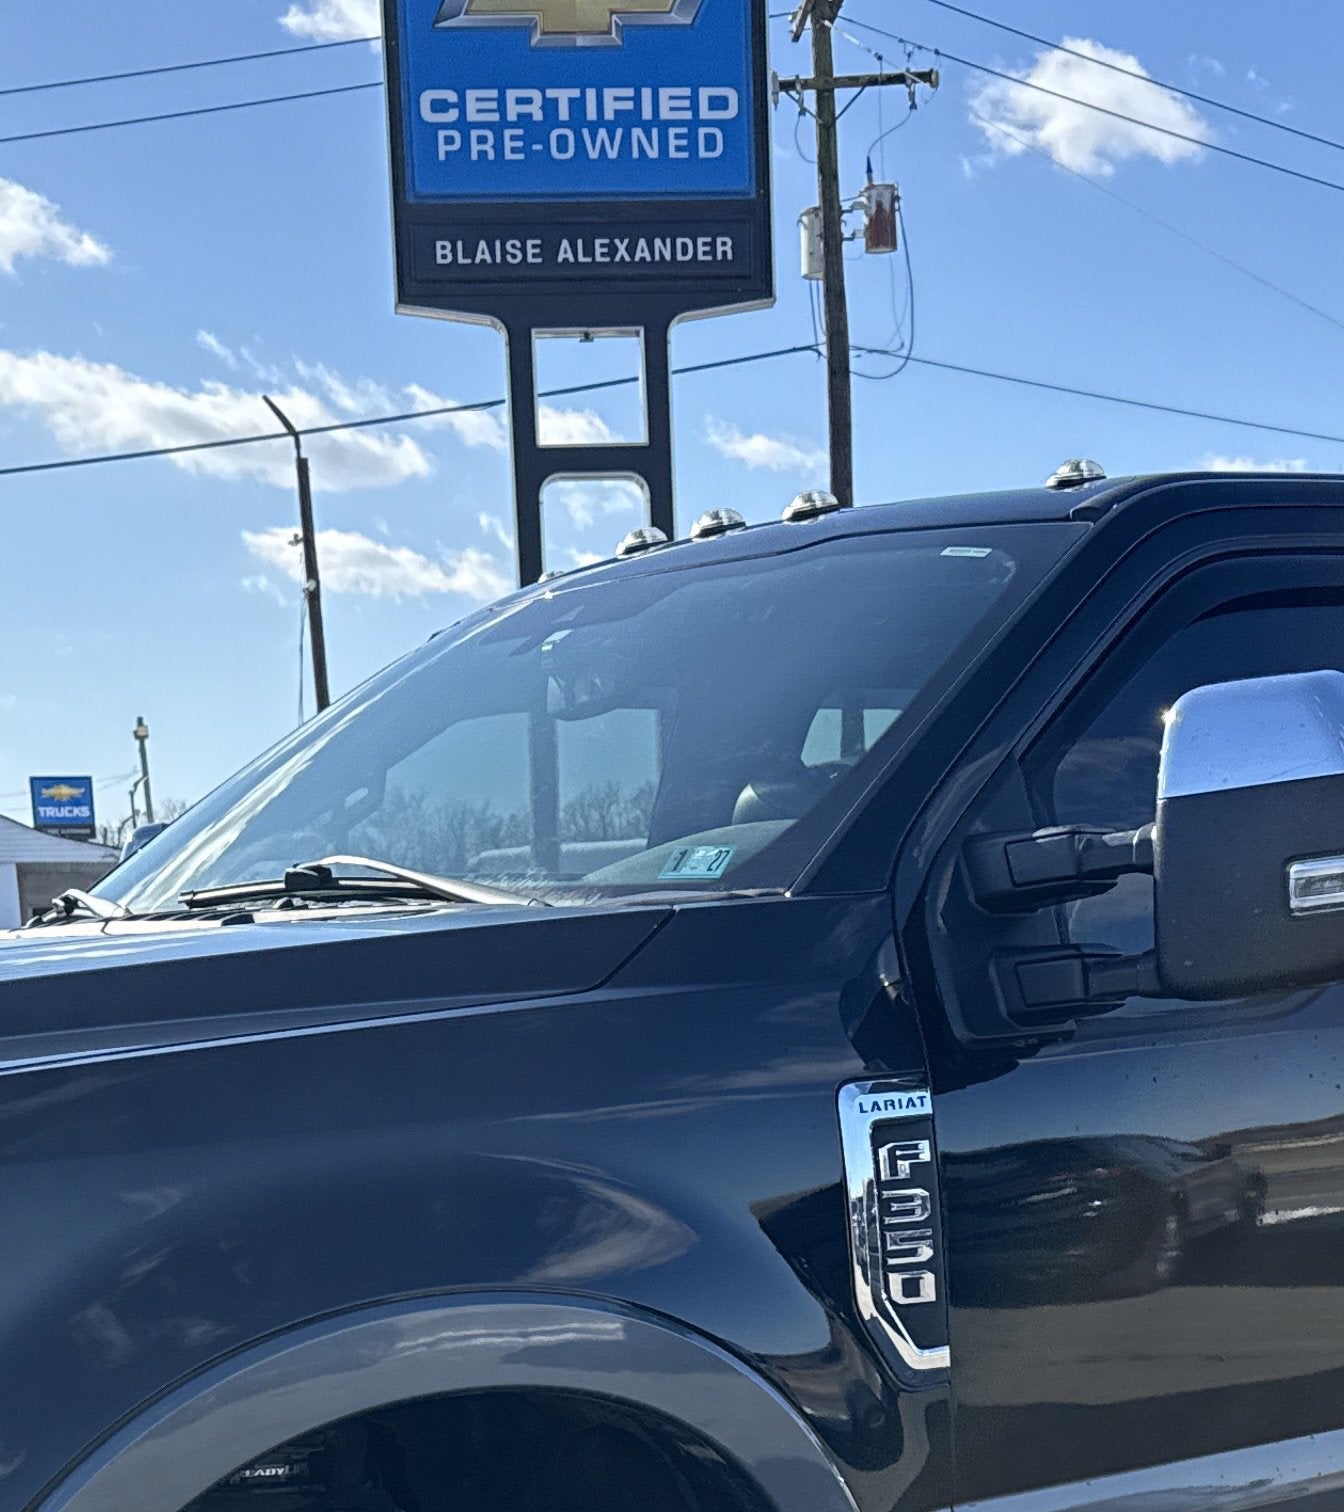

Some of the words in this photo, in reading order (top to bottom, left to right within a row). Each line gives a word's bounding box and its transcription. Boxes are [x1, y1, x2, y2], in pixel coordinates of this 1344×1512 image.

[419, 86, 739, 123] CERTIFIED
[436, 126, 725, 161] PRE-OWNED
[434, 238, 543, 265] BLAISE
[557, 235, 734, 263] ALEXANDER
[37, 805, 91, 818] TRUCKS
[706, 849, 731, 873] 27
[858, 1095, 928, 1114] LARIAT
